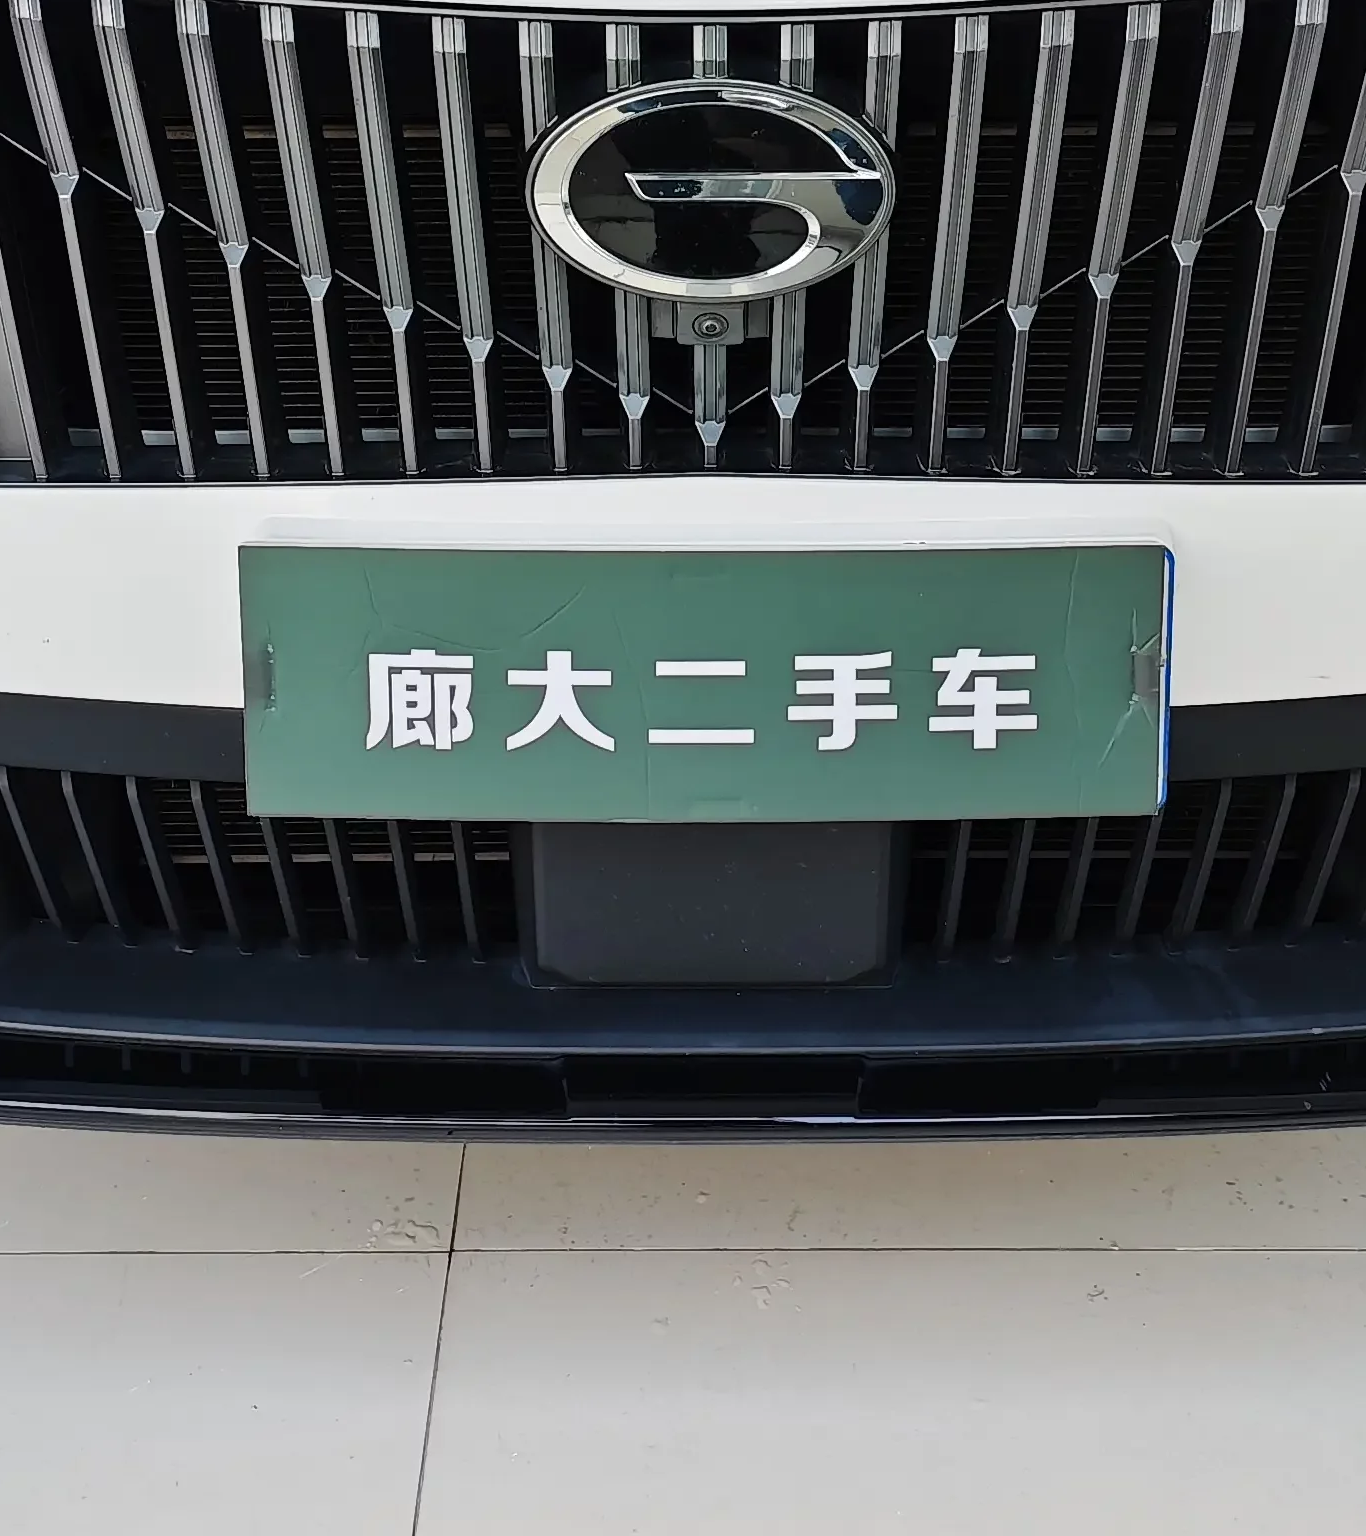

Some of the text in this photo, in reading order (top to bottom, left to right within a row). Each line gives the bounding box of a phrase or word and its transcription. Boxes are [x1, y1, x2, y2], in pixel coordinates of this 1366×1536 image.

[366, 648, 1039, 752] 廊大二手车
